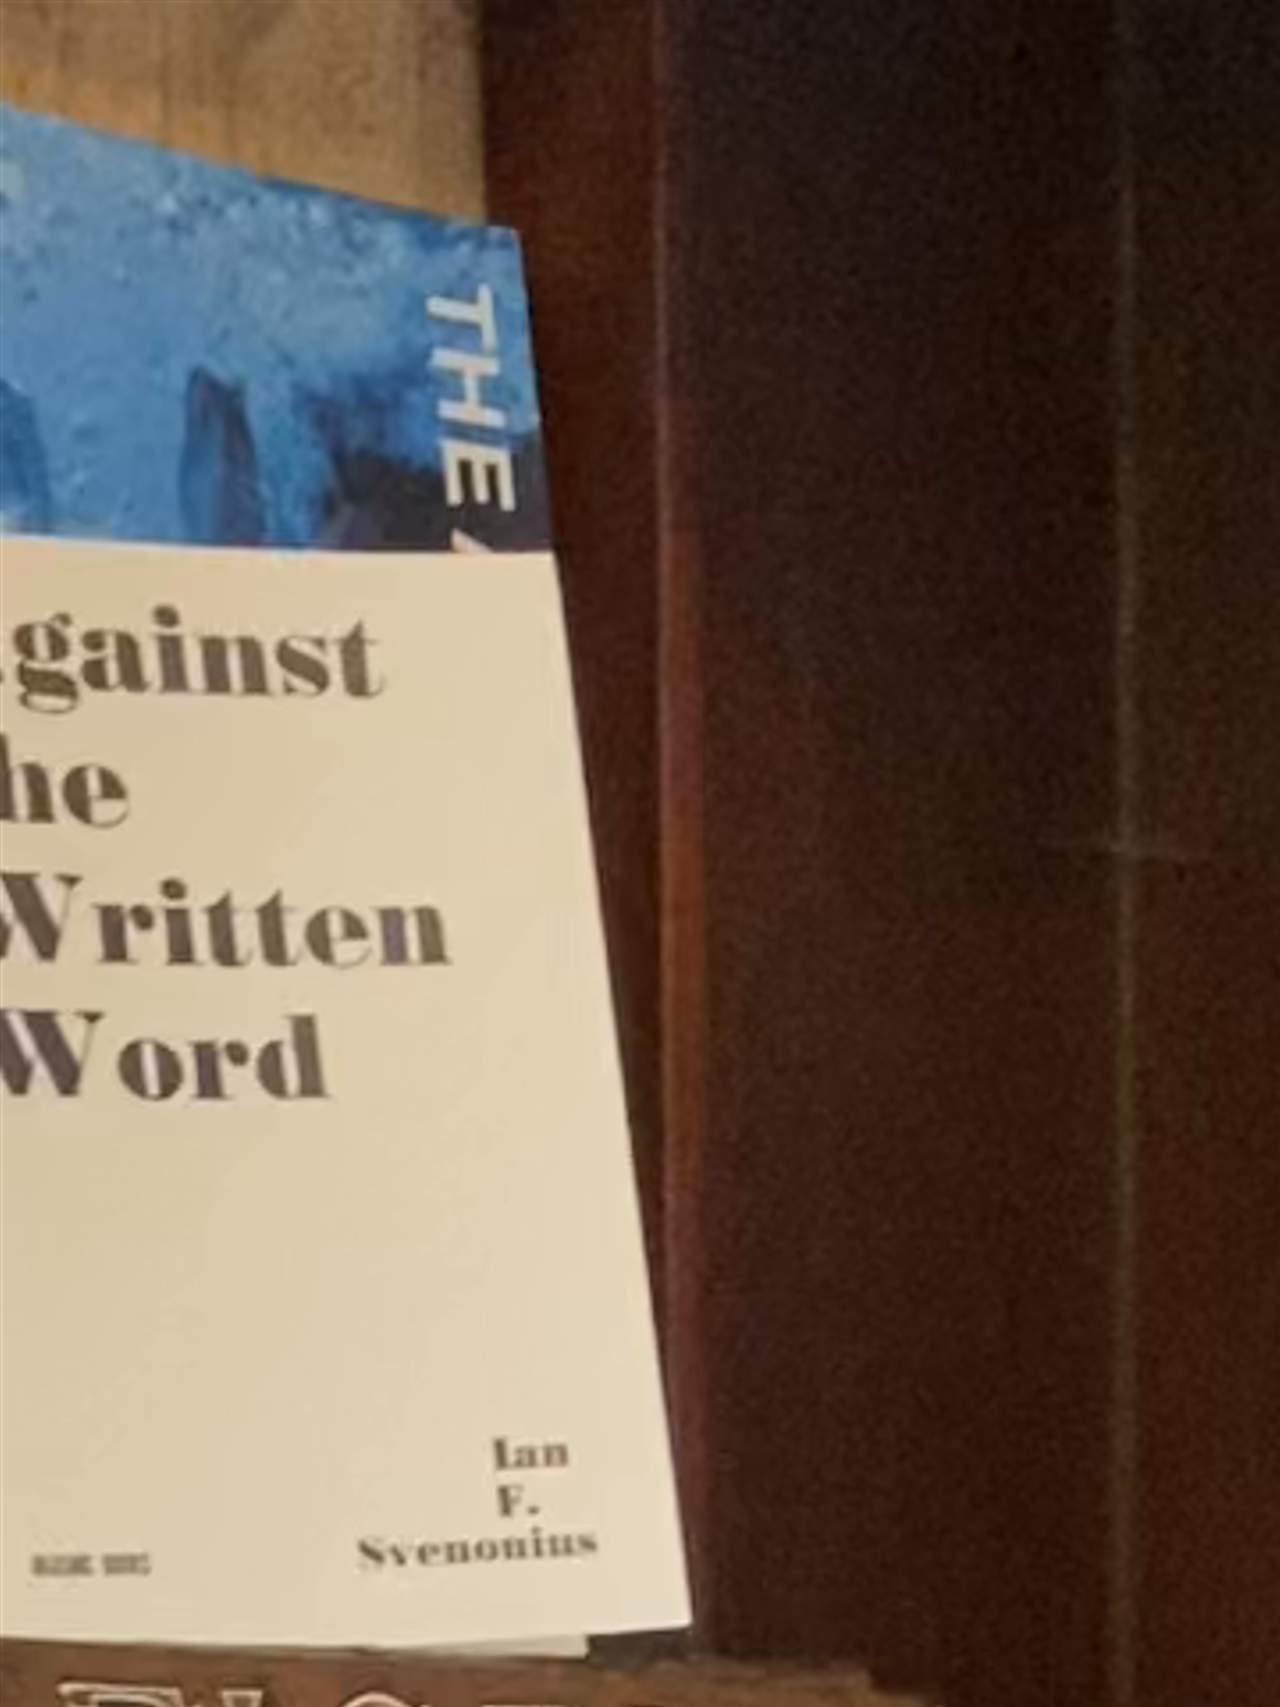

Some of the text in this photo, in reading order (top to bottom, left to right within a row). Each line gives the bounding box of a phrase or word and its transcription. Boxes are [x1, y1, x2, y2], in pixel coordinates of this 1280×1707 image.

[426, 285, 516, 512] THE
[0, 605, 387, 713] gainst
[0, 735, 130, 828] he
[0, 872, 452, 968] Written
[0, 1008, 331, 1102] Word
[492, 1436, 570, 1472] Ian
[497, 1484, 541, 1518] F.
[356, 1526, 600, 1573] Svenonius
